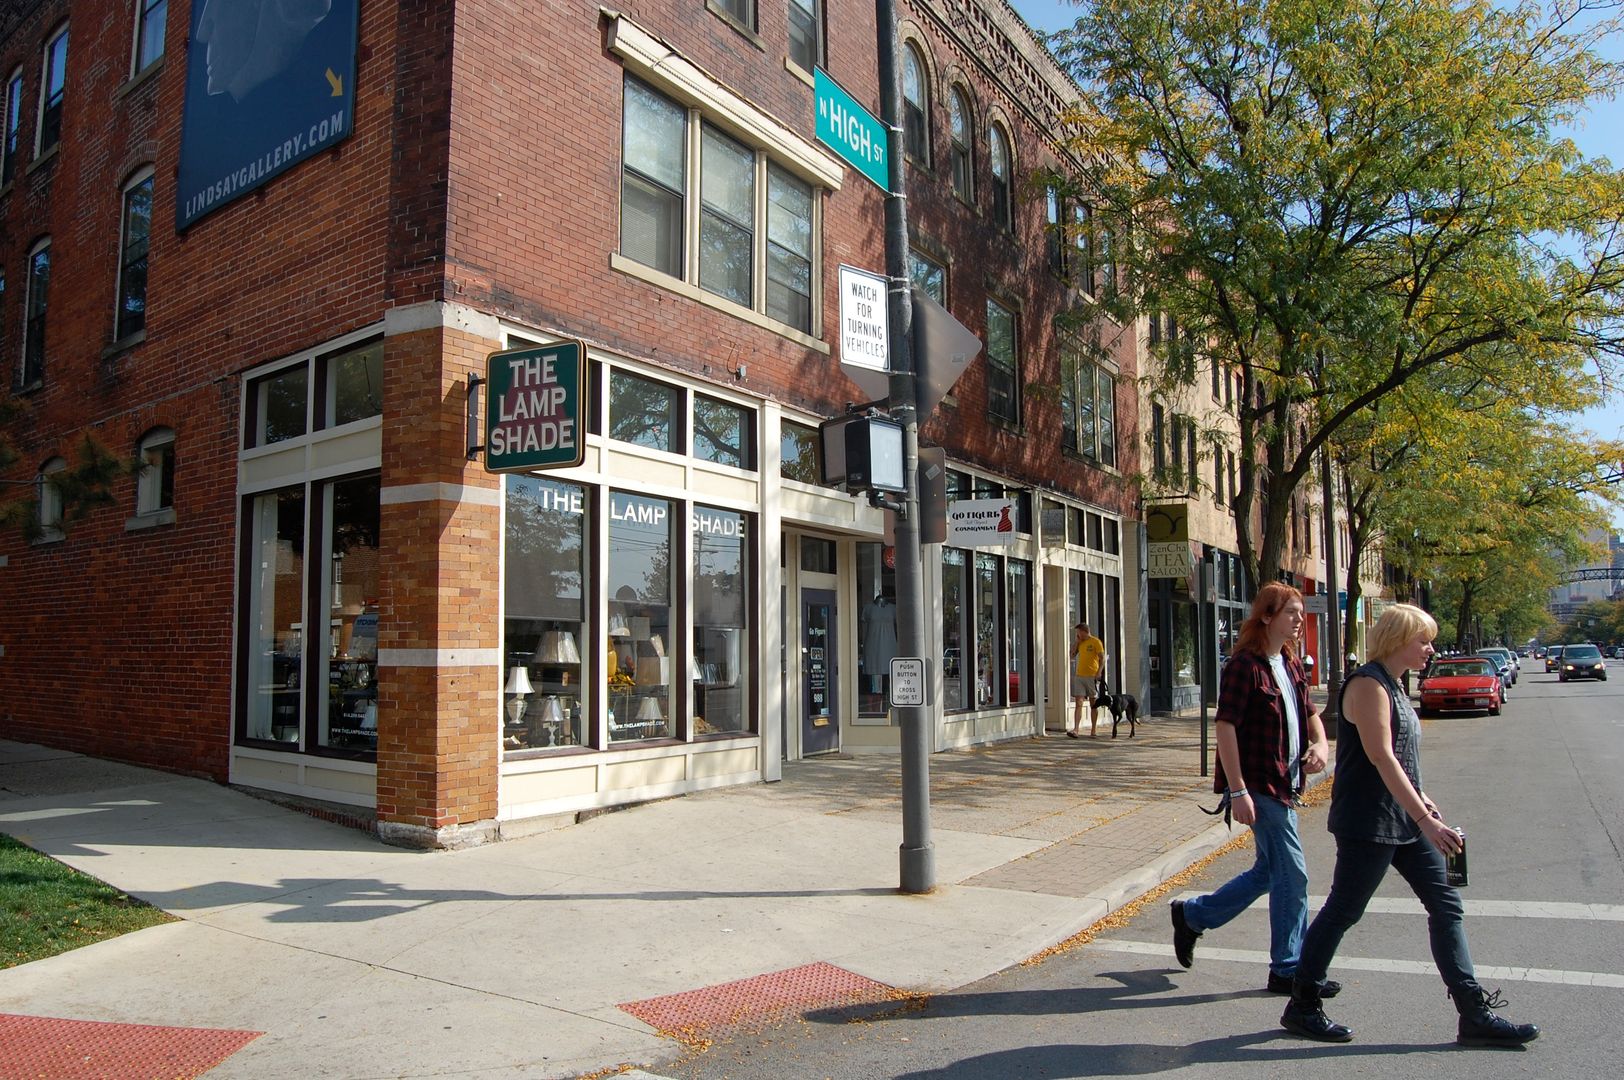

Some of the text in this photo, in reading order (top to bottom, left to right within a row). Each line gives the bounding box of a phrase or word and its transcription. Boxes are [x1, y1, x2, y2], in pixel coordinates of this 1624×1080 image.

[819, 96, 884, 165] N HIGH ST
[185, 110, 344, 219] LINDSAYGALLERY.COM
[851, 282, 877, 302] WATCH
[857, 302, 872, 319] FOR
[847, 318, 883, 340] TURNING
[846, 336, 885, 358] VEHICLES
[508, 353, 558, 388] THE
[499, 387, 567, 423] LAMP
[490, 419, 575, 456] SHADE
[538, 486, 745, 538] THE LAMP SHADE
[952, 511, 1000, 520] GO FIGURE
[1149, 543, 1187, 554] ZenCha
[1150, 553, 1185, 567] TEA
[1150, 567, 1187, 577] SALON
